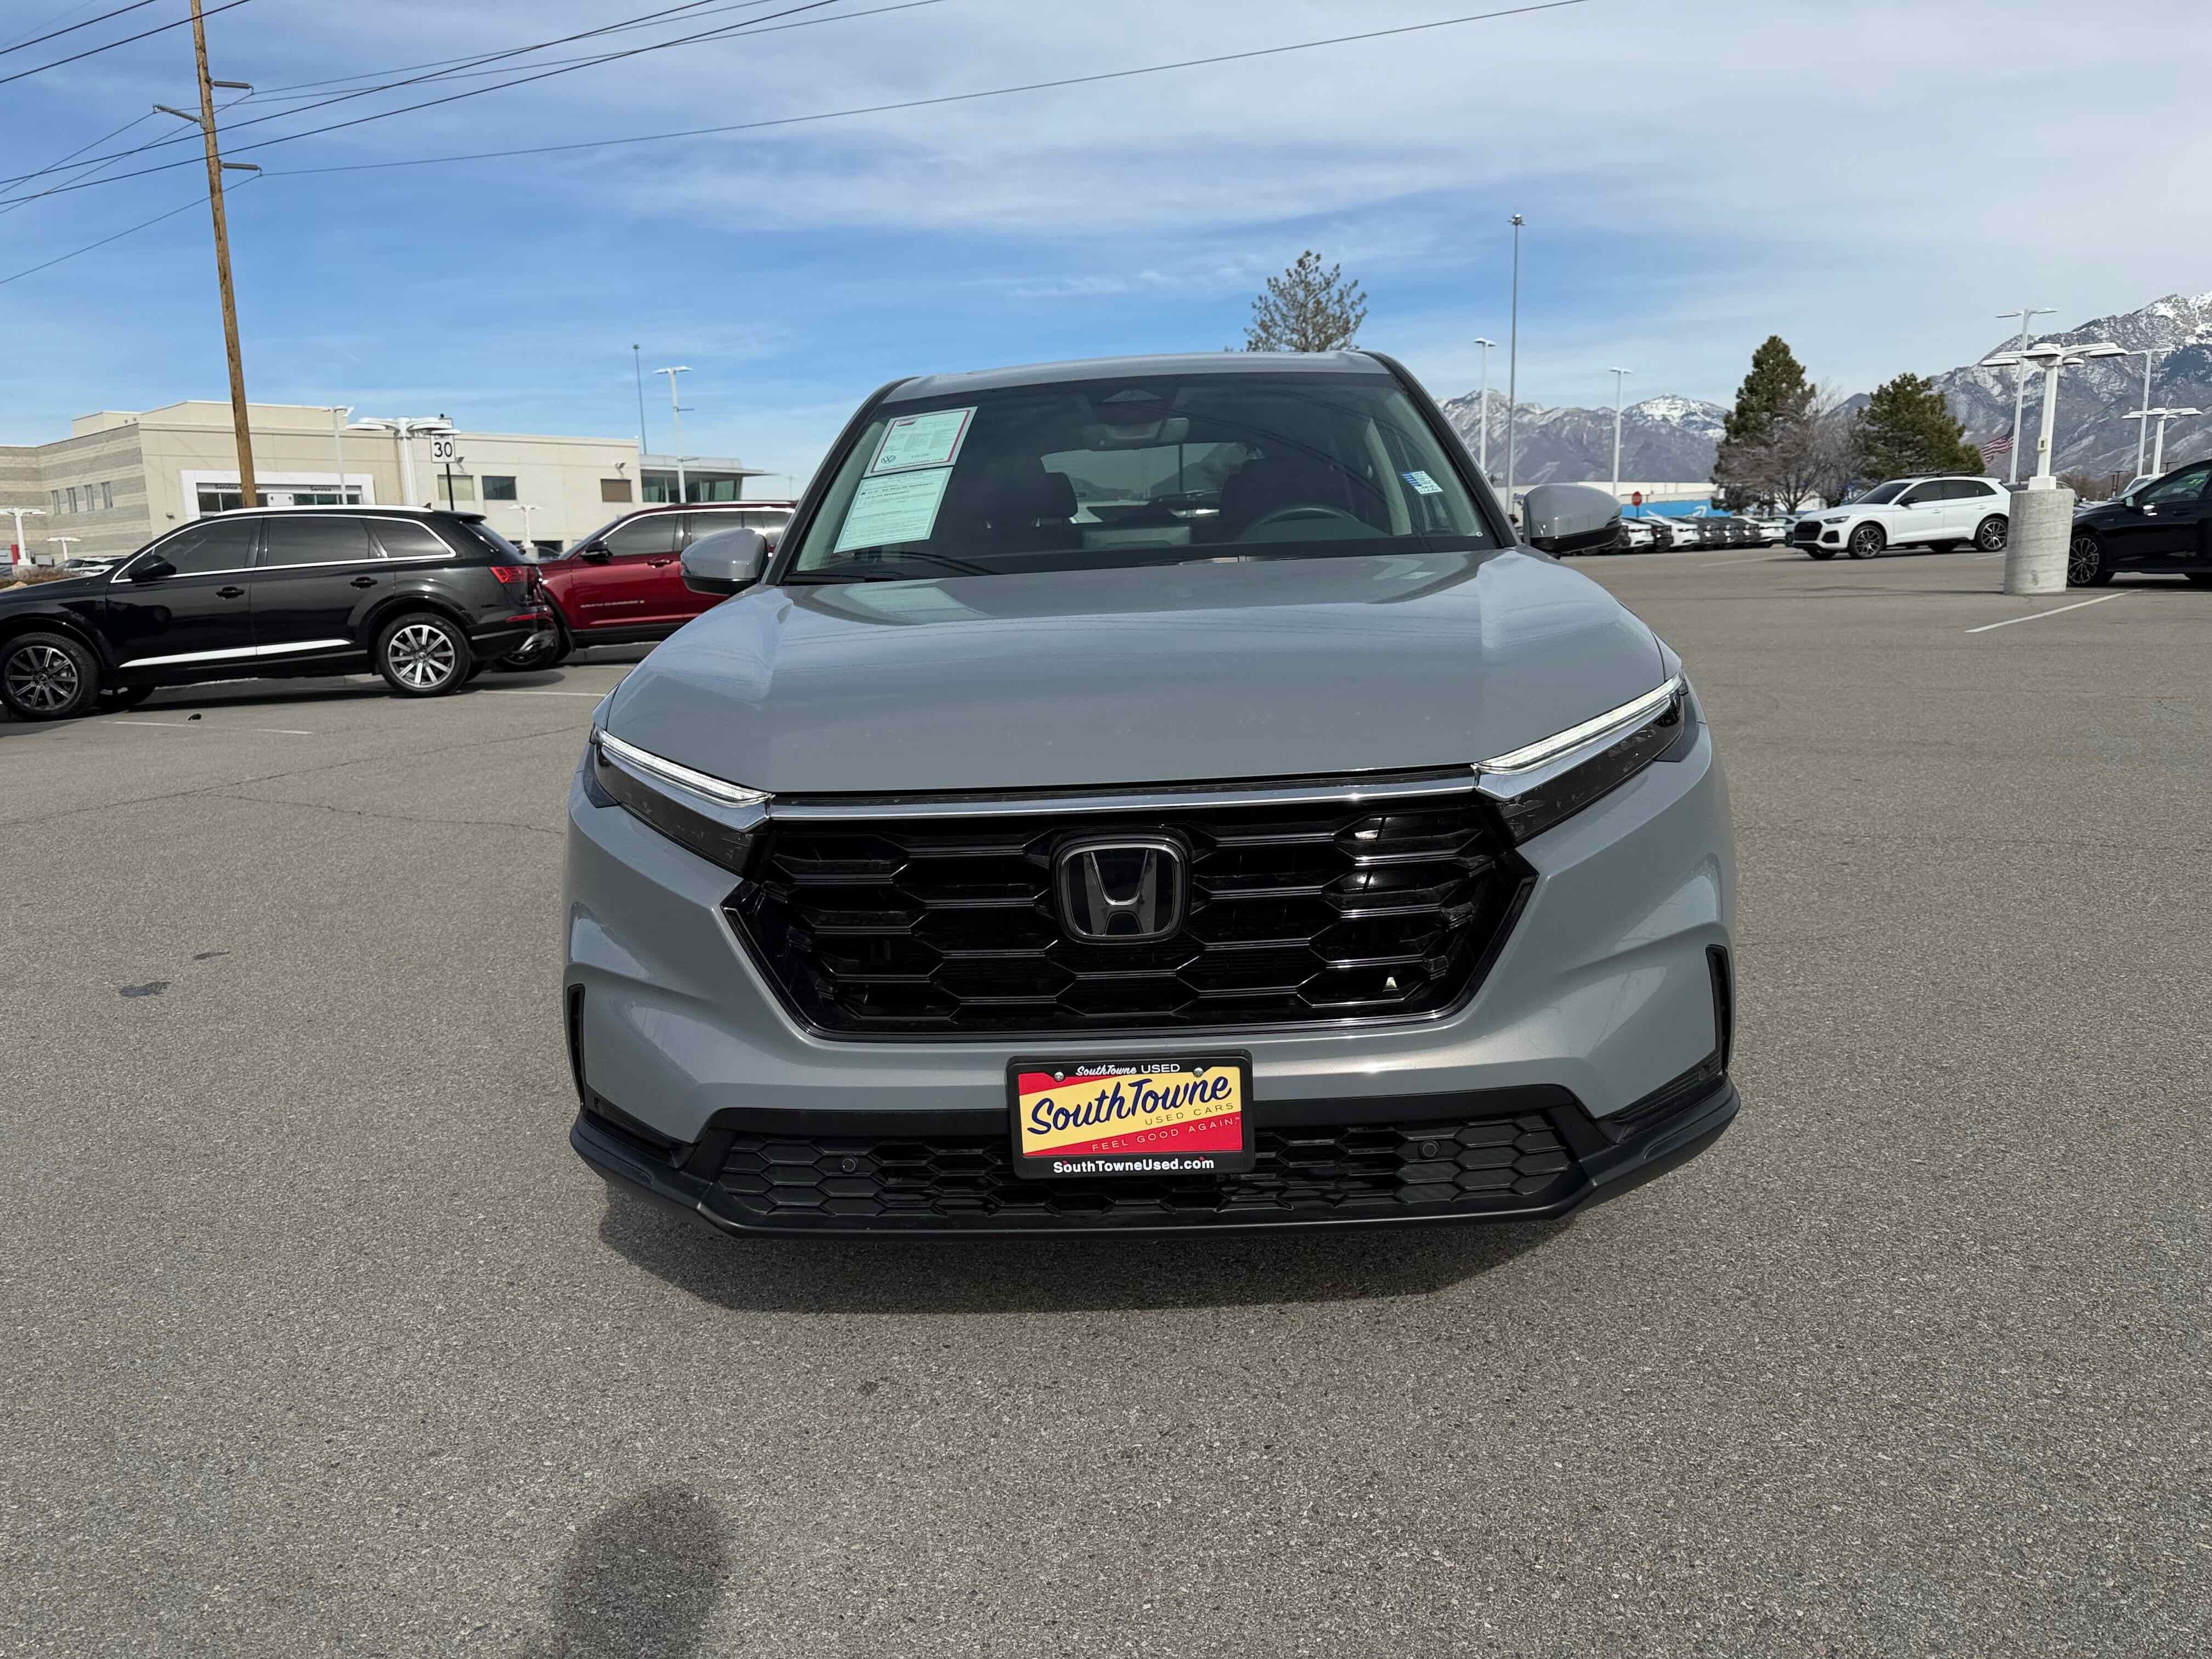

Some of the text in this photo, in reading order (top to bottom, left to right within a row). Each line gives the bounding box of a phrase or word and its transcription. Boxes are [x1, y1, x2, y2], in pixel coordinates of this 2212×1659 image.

[434, 442, 453, 458] 30
[1075, 1063, 1181, 1076] SouthTowne USED
[1026, 1076, 1232, 1135] SouthTowne
[1144, 1102, 1234, 1126] USED CARS
[1092, 1138, 1128, 1152] FEEL
[1136, 1128, 1179, 1143] GOOD
[1053, 1158, 1215, 1174] SouthTowneUsed.com
